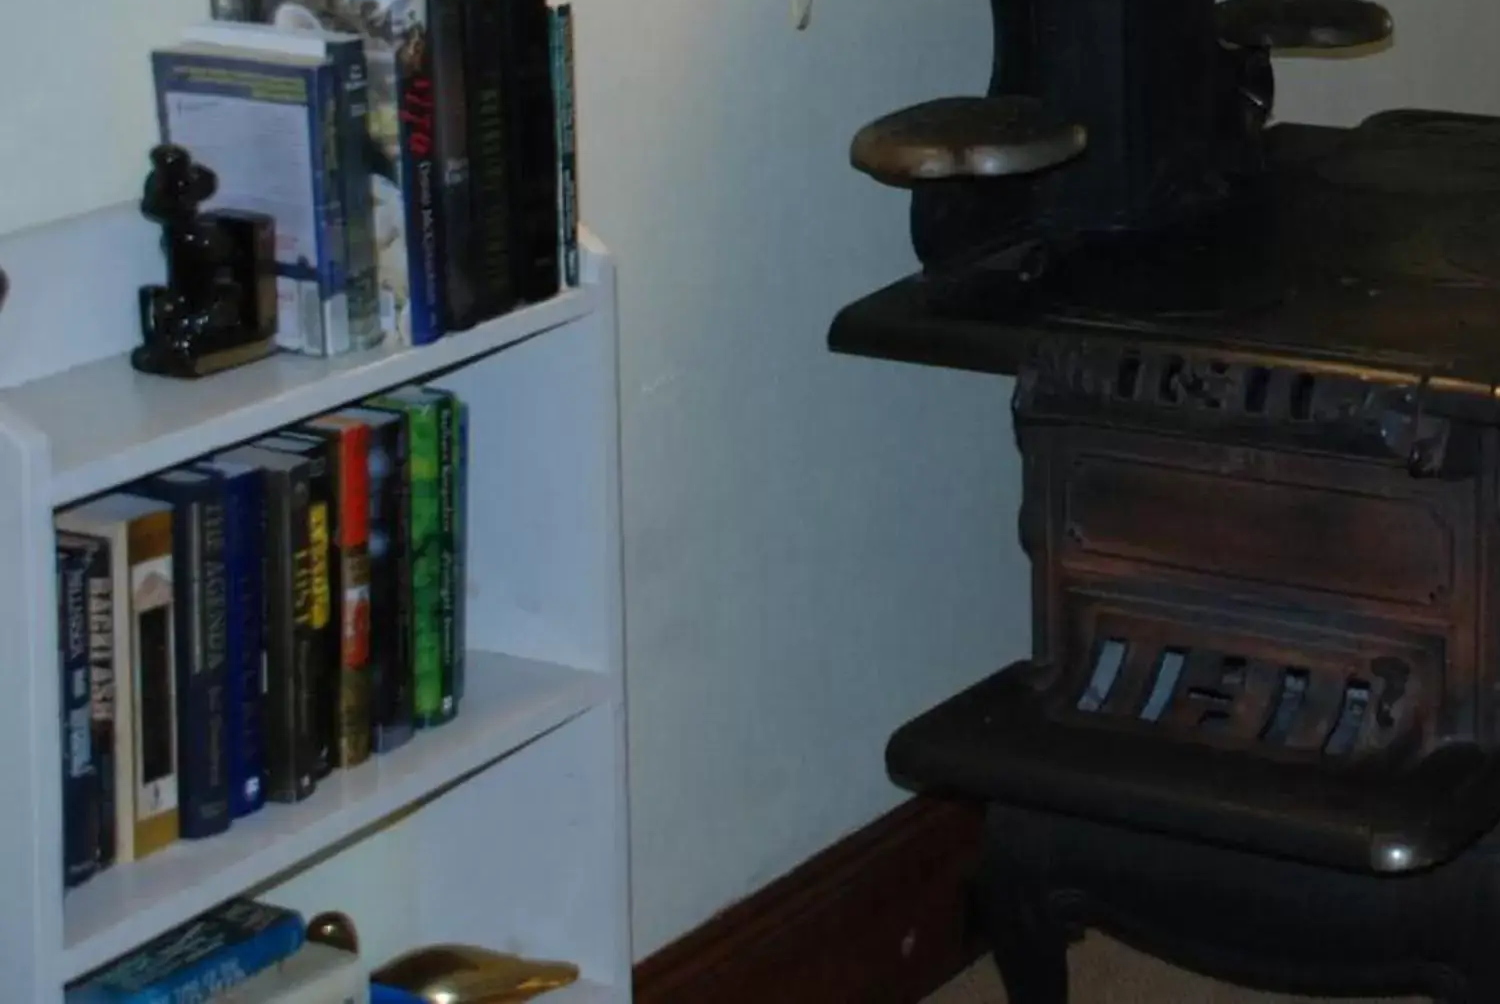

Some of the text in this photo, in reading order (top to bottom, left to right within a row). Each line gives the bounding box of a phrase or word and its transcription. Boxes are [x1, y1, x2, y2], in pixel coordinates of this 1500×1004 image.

[204, 504, 224, 548] THE
[90, 577, 113, 722] BACKLASH
[205, 560, 227, 669] AGENDA
